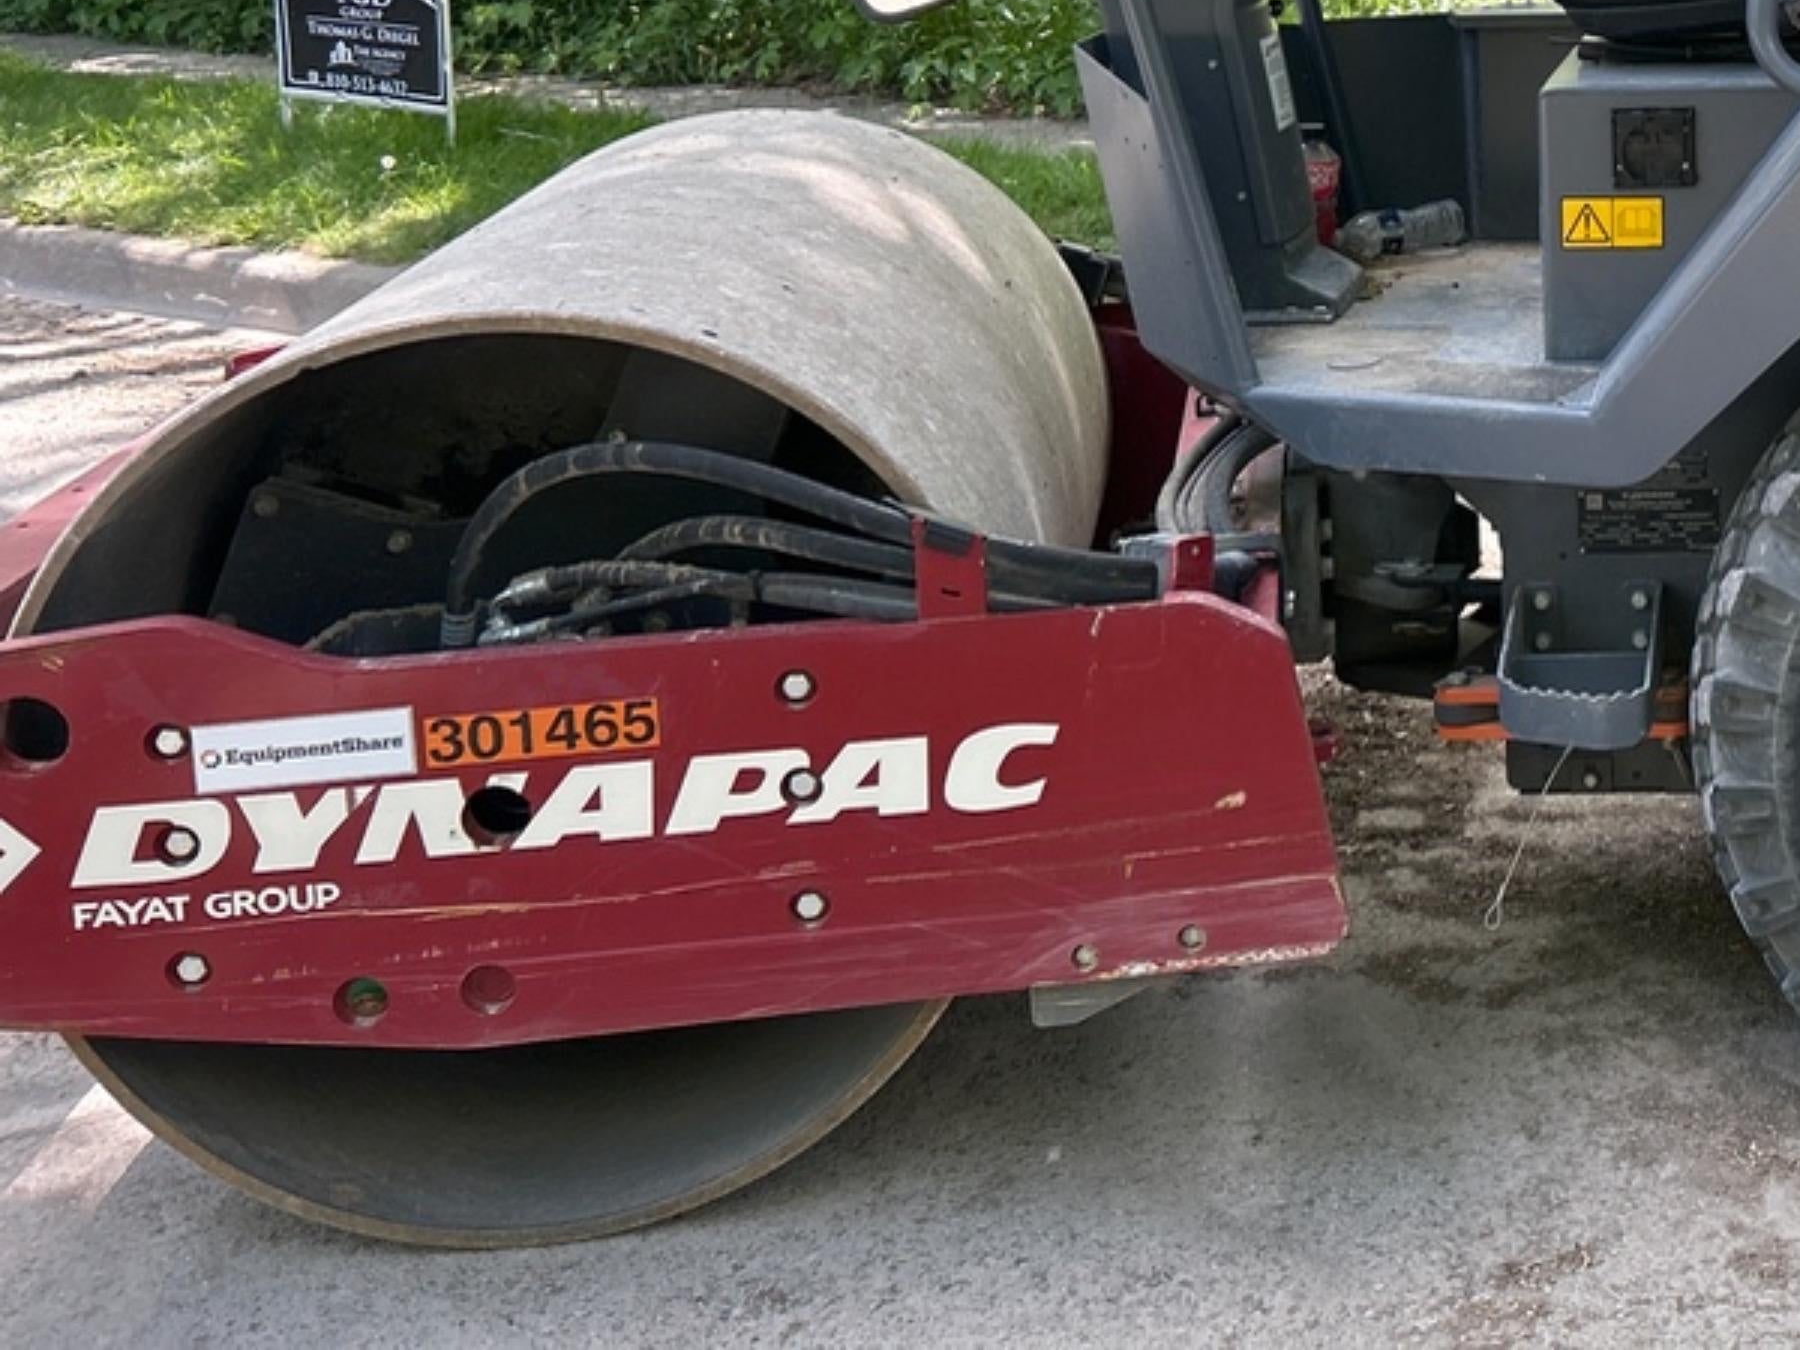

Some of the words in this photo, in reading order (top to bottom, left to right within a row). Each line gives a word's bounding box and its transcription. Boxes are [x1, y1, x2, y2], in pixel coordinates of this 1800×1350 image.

[224, 734, 404, 767] EquipmentShare
[428, 700, 656, 764] 301465
[70, 724, 1058, 888] DYNAPAC
[73, 895, 190, 932] FAYAT
[204, 883, 342, 919] GROUP
